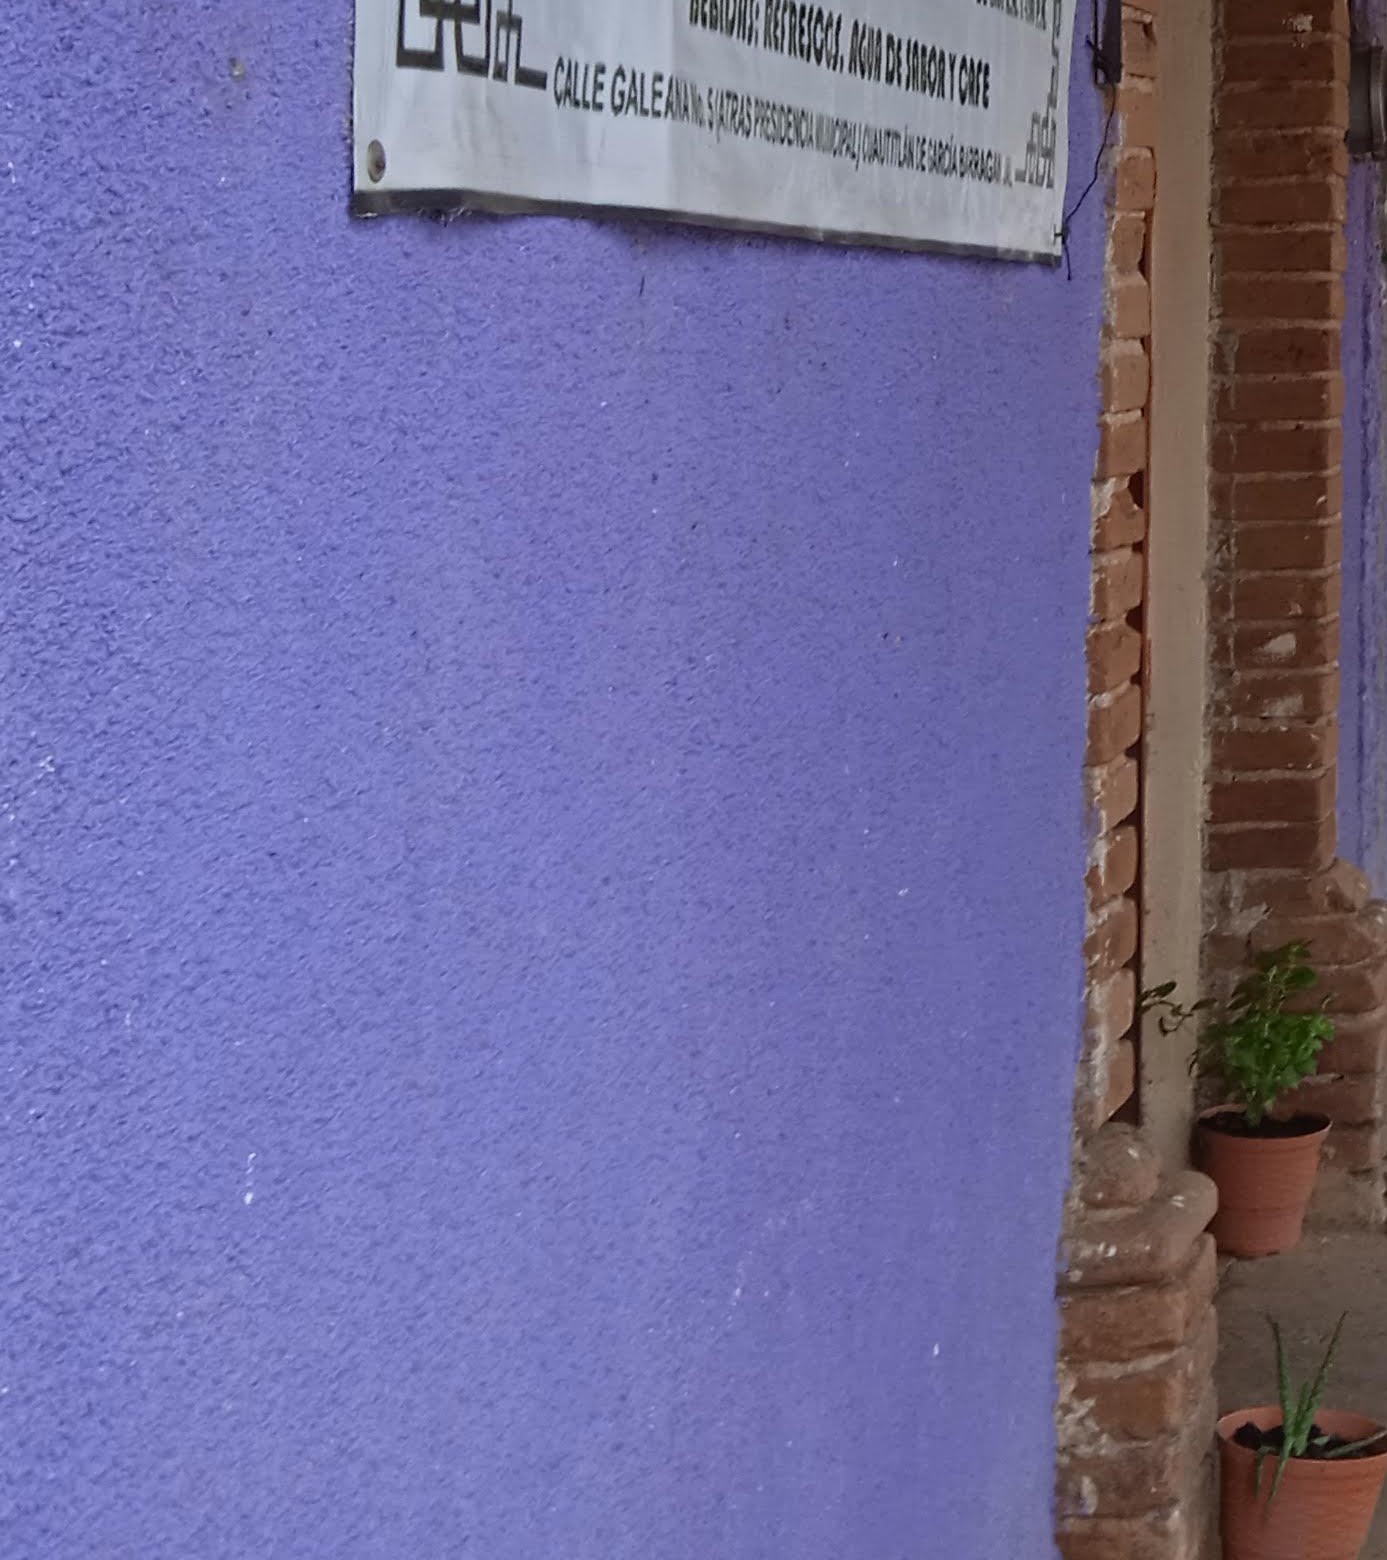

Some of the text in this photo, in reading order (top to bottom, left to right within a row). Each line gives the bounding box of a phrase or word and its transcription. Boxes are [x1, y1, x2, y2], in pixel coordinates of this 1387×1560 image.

[553, 55, 606, 112] CALLE
[610, 63, 690, 123] GALEANA
[849, 18, 882, 83] AGUA
[885, 32, 903, 87] DE
[905, 39, 946, 99] SABOR
[949, 51, 957, 102] Y
